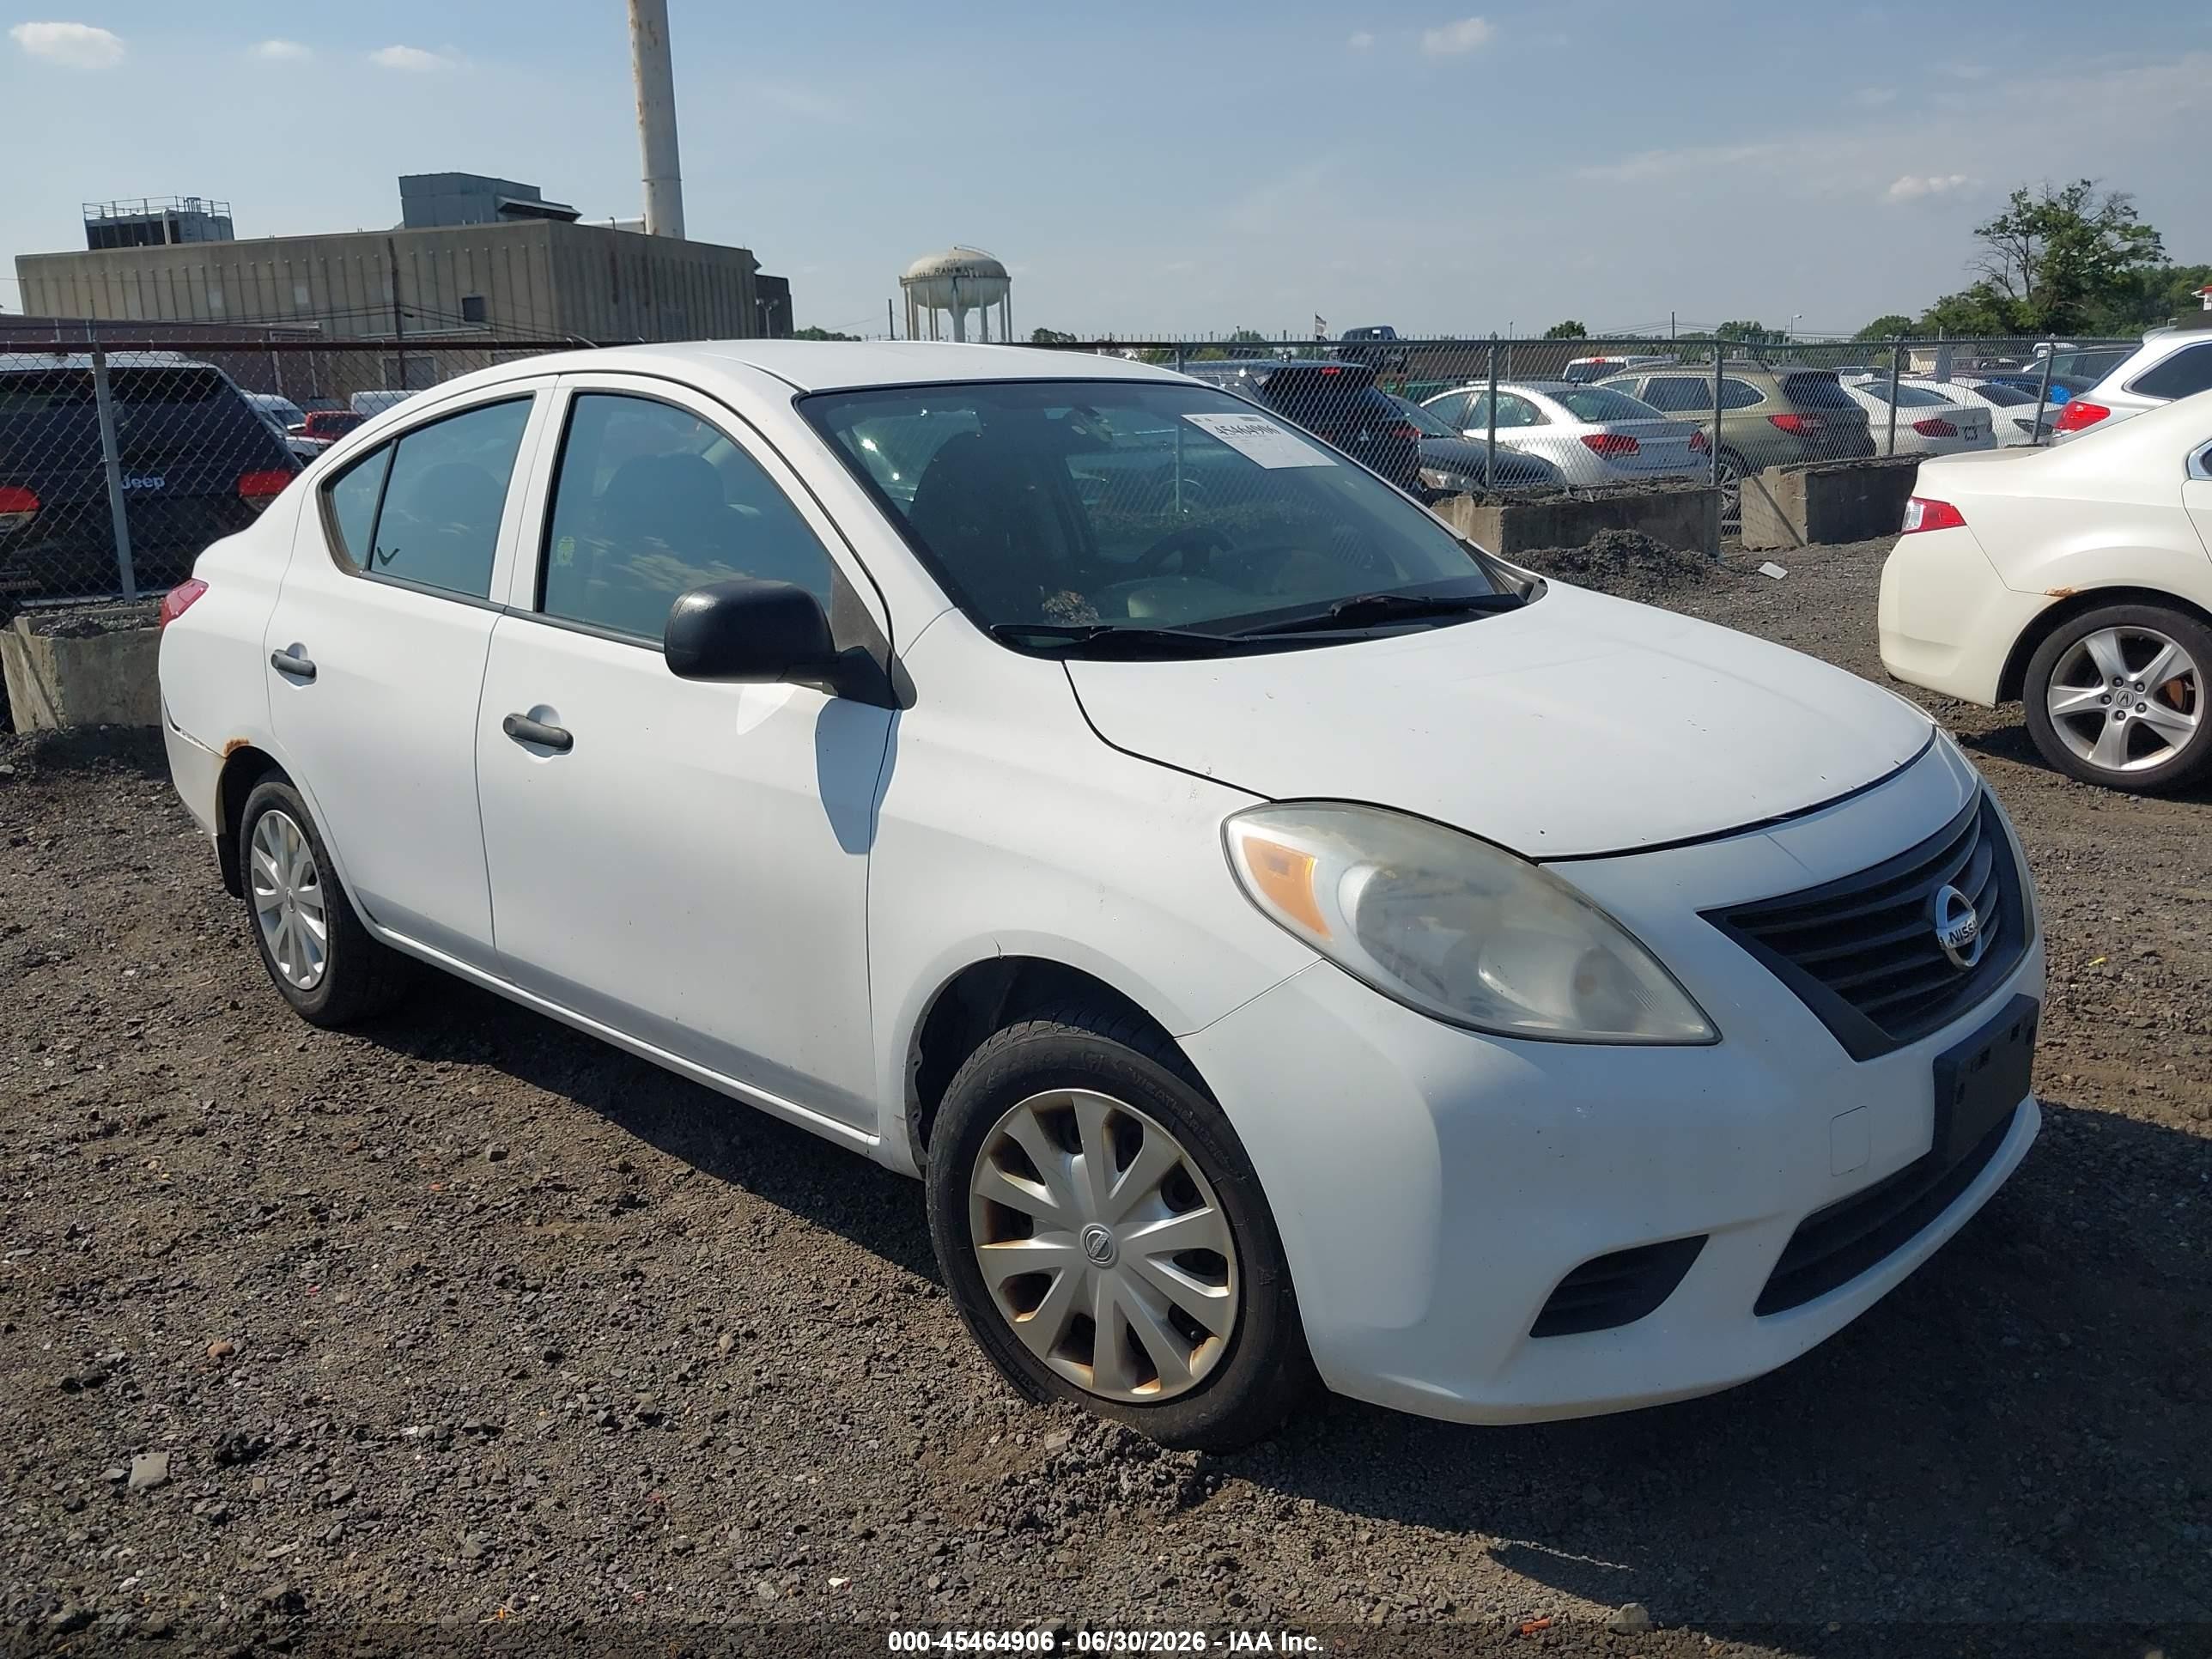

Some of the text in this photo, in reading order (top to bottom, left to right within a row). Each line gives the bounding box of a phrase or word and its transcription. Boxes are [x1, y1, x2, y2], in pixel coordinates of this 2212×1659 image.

[1213, 424, 1282, 436] 45464906
[121, 475, 166, 490] Jeep
[1948, 920, 1978, 944] NISS
